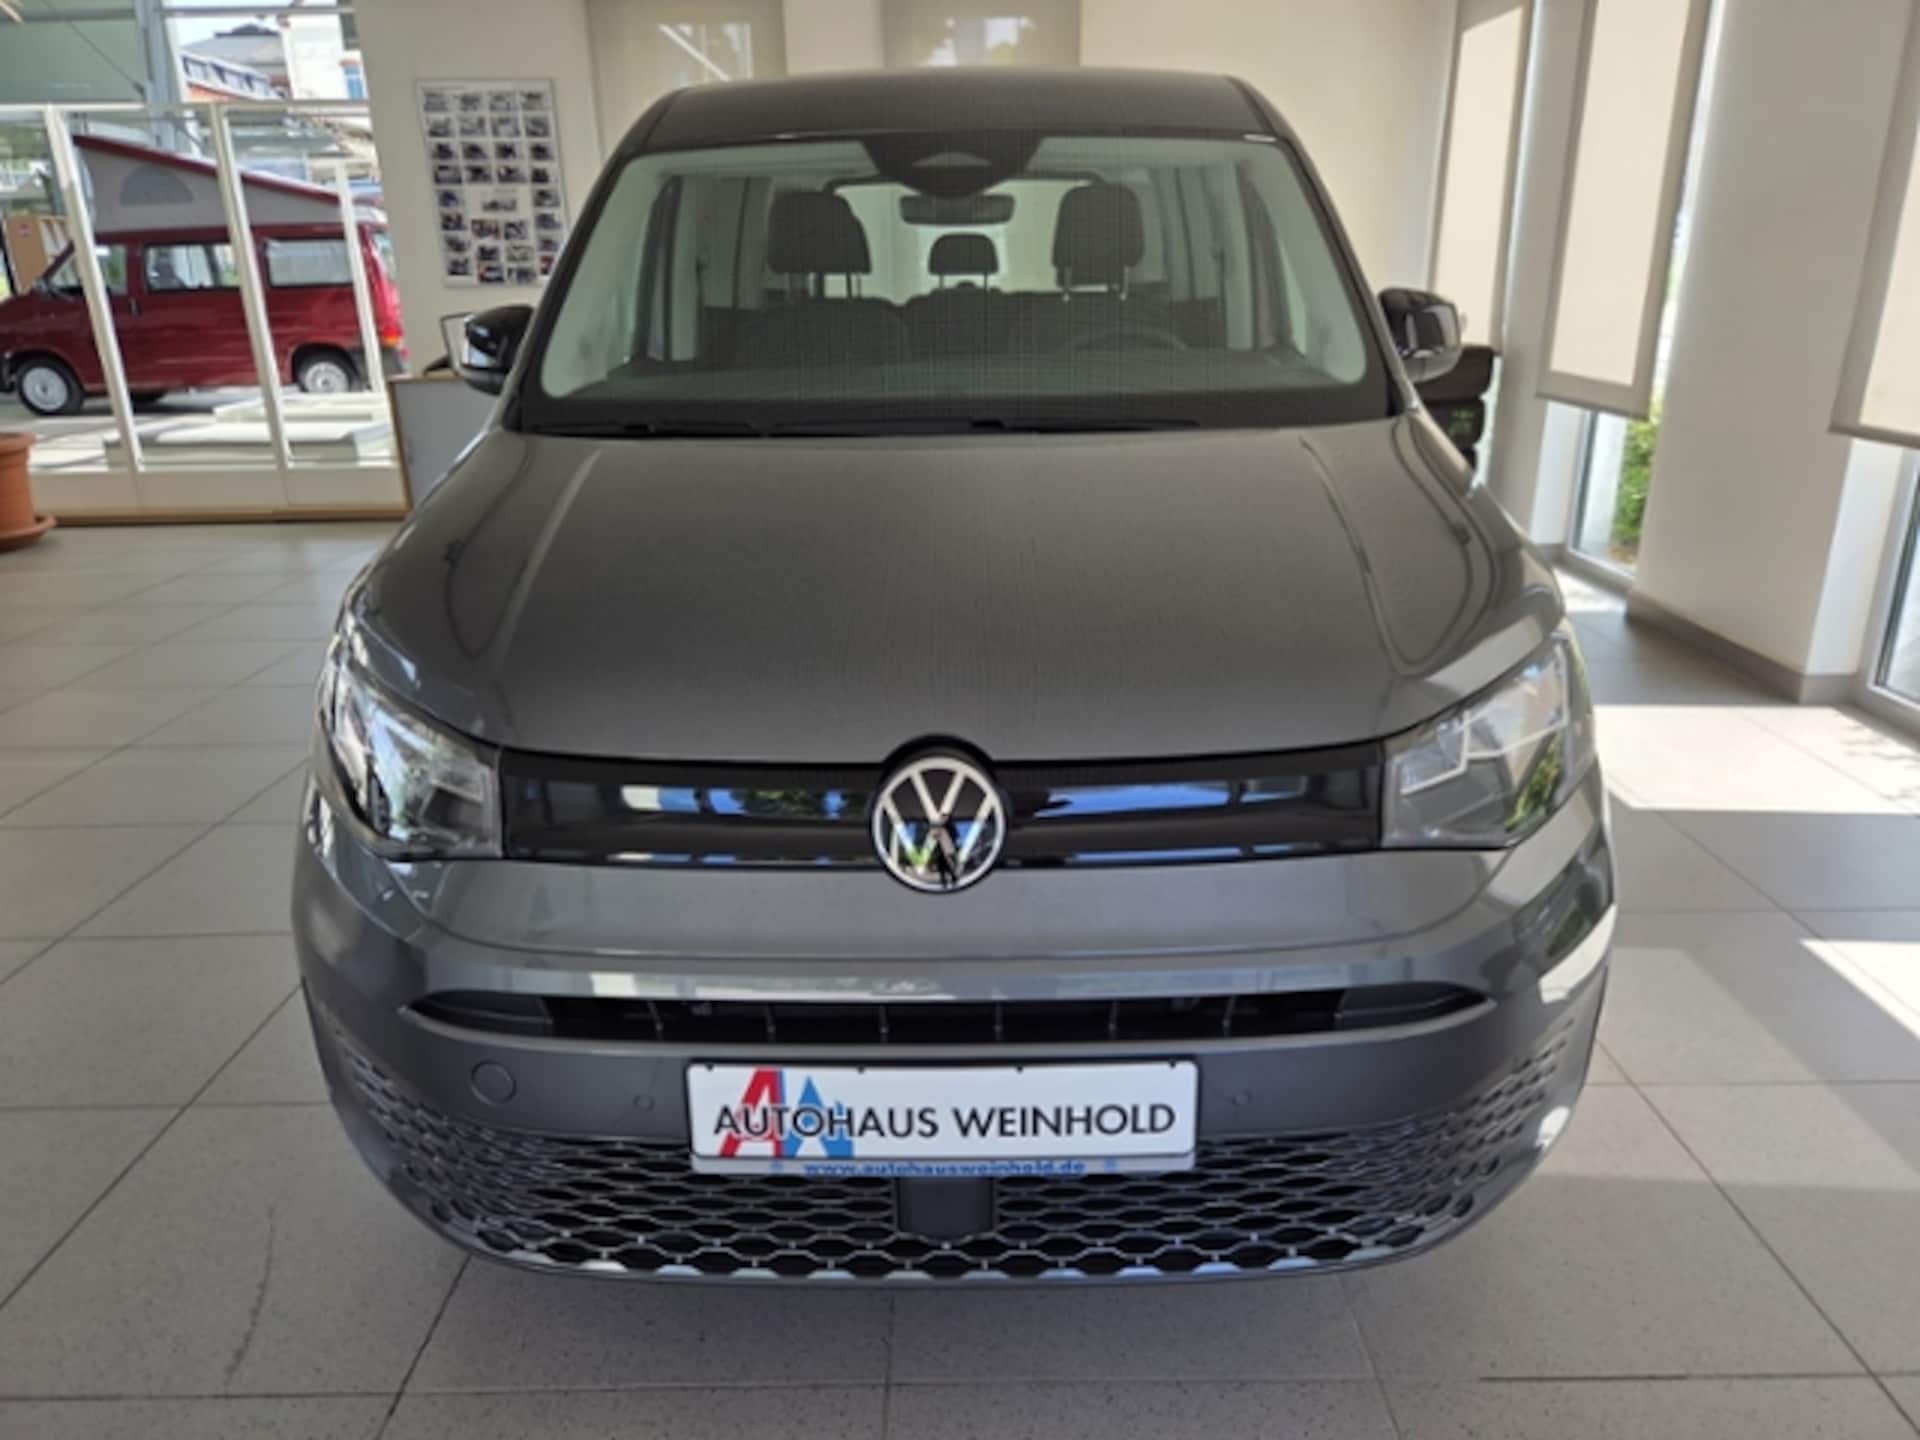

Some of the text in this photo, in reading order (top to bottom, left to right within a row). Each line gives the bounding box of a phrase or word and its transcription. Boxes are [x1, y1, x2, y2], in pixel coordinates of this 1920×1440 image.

[714, 1103, 1176, 1138] AUTOHAUS WEINHOLD
[804, 1160, 1086, 1177] www.autohausweinhold.de
